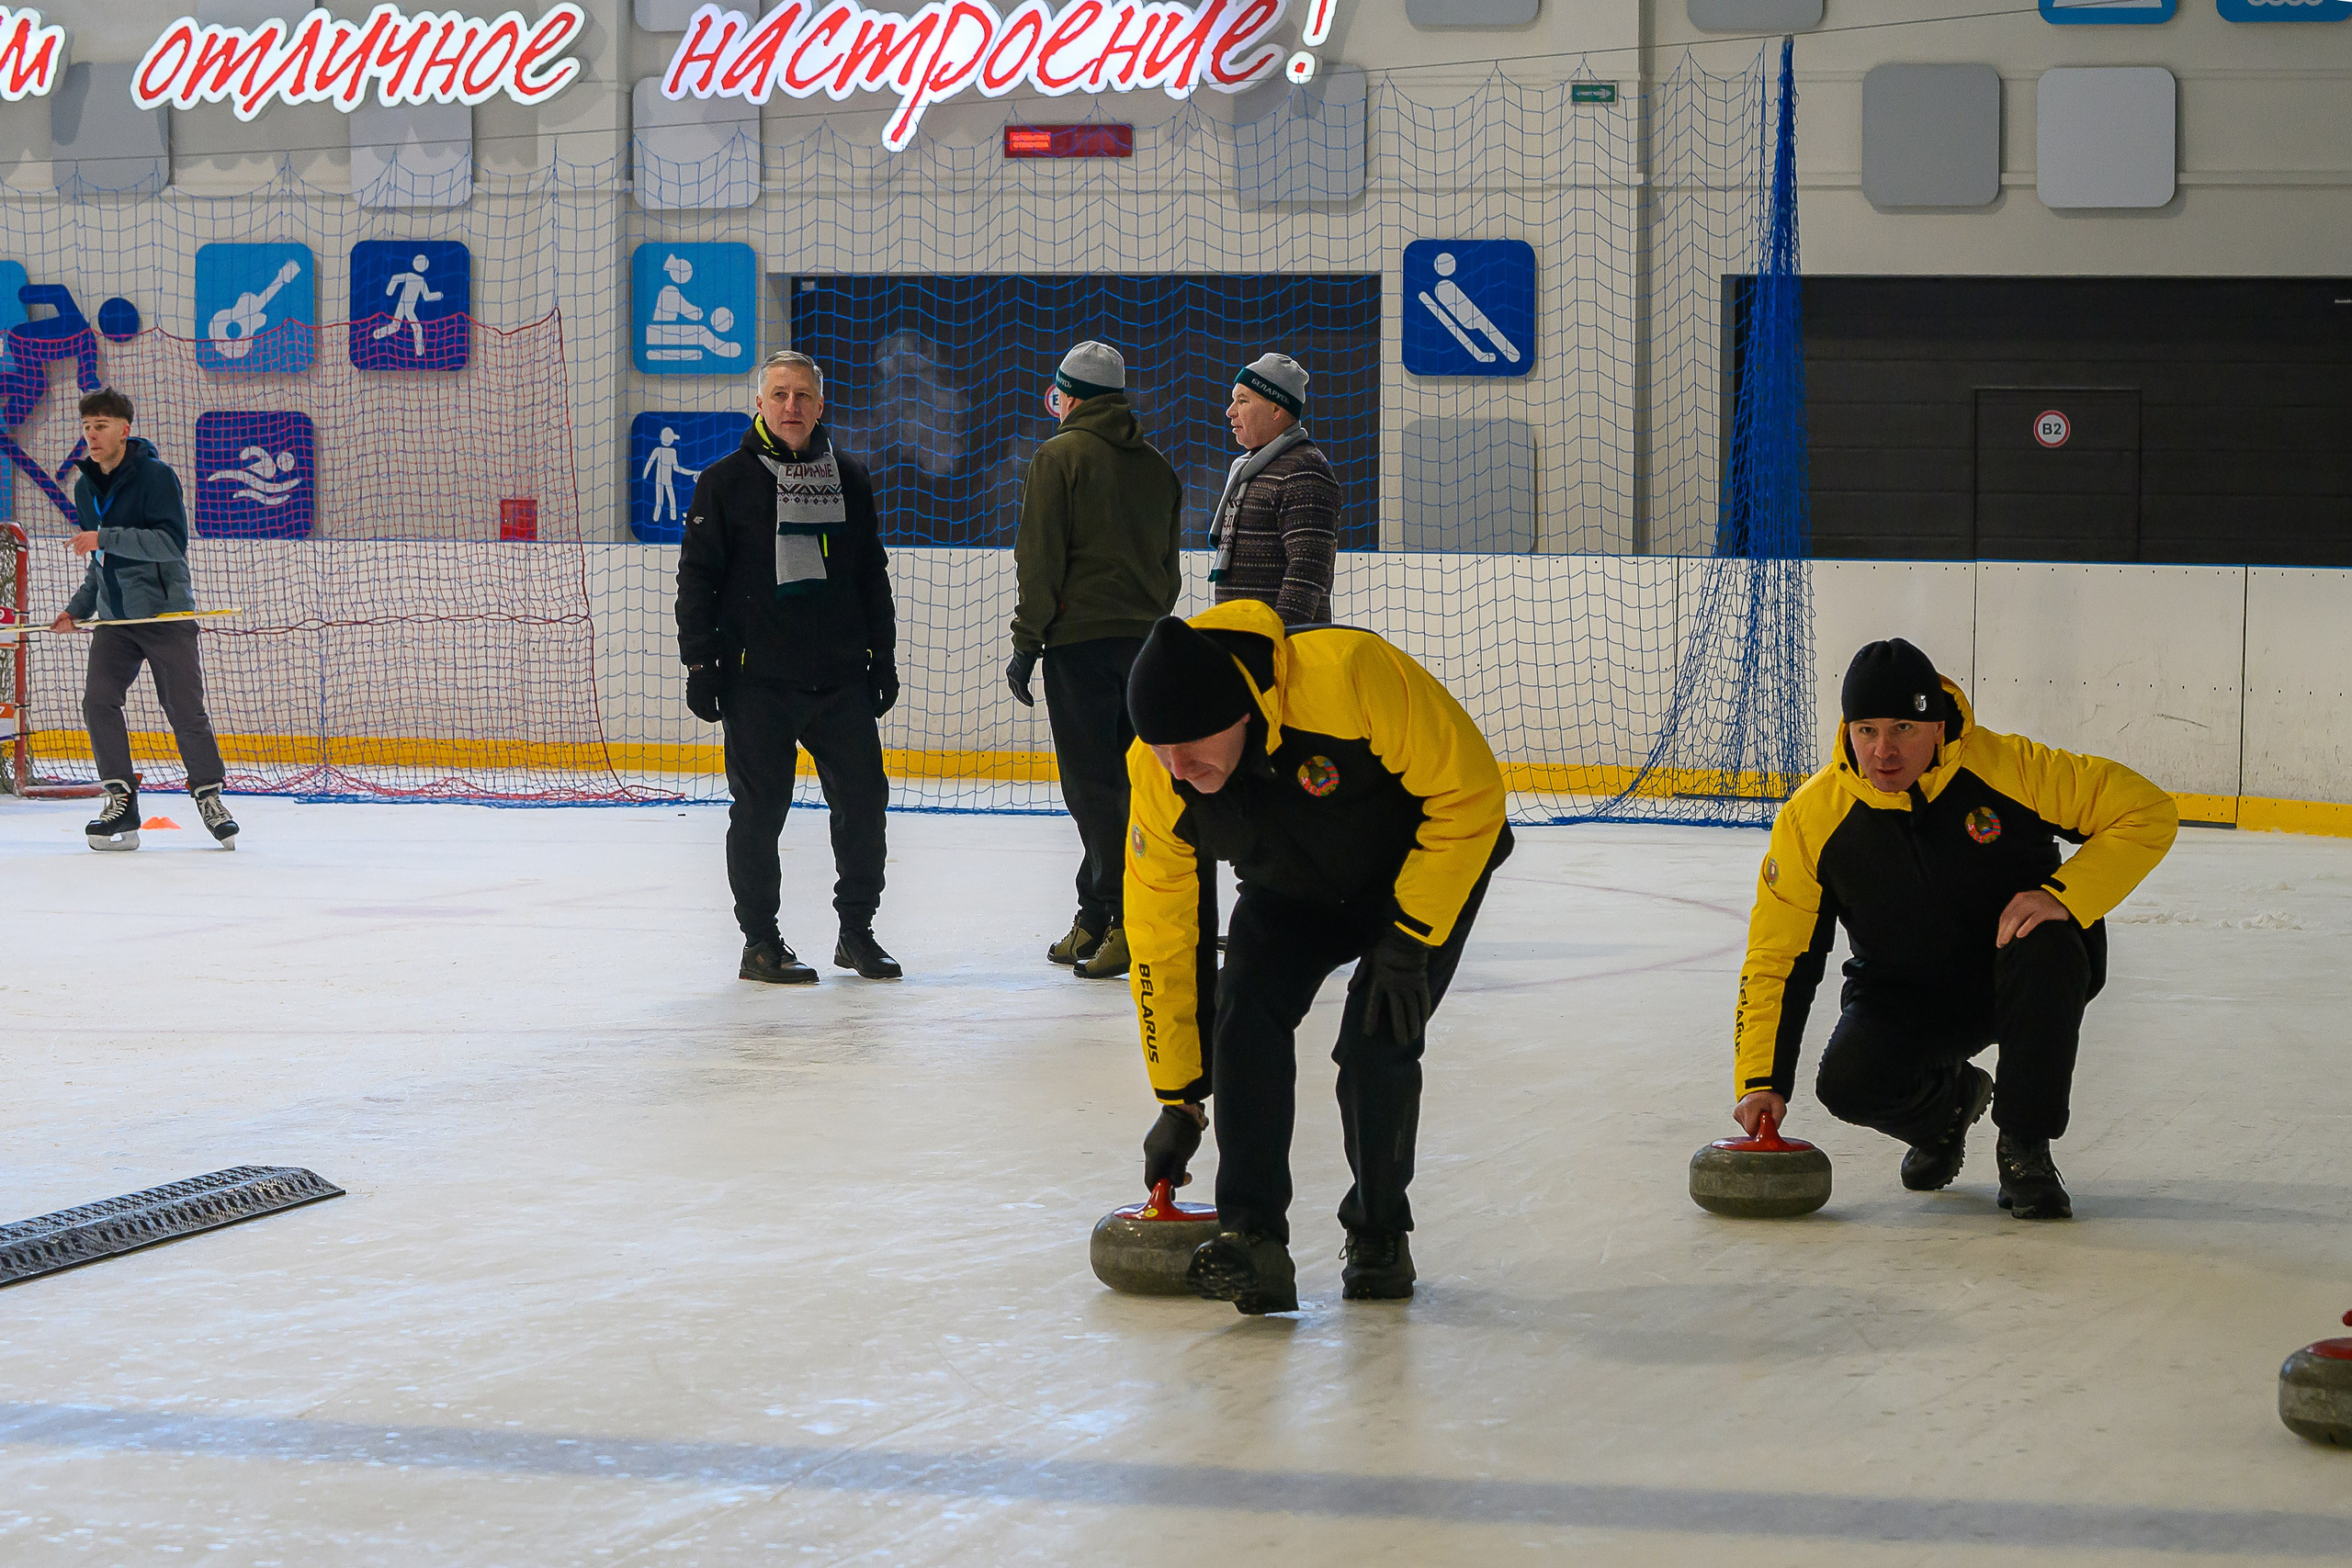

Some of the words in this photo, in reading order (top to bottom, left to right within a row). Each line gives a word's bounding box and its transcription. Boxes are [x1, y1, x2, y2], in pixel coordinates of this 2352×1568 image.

[139, 12, 575, 113] отличное
[669, 0, 1328, 141] настроение!
[1251, 378, 1290, 404] БЕЛАРУСЬ
[785, 463, 834, 479] ЕДИНЫЕ
[1138, 963, 1159, 1064] BELARUS
